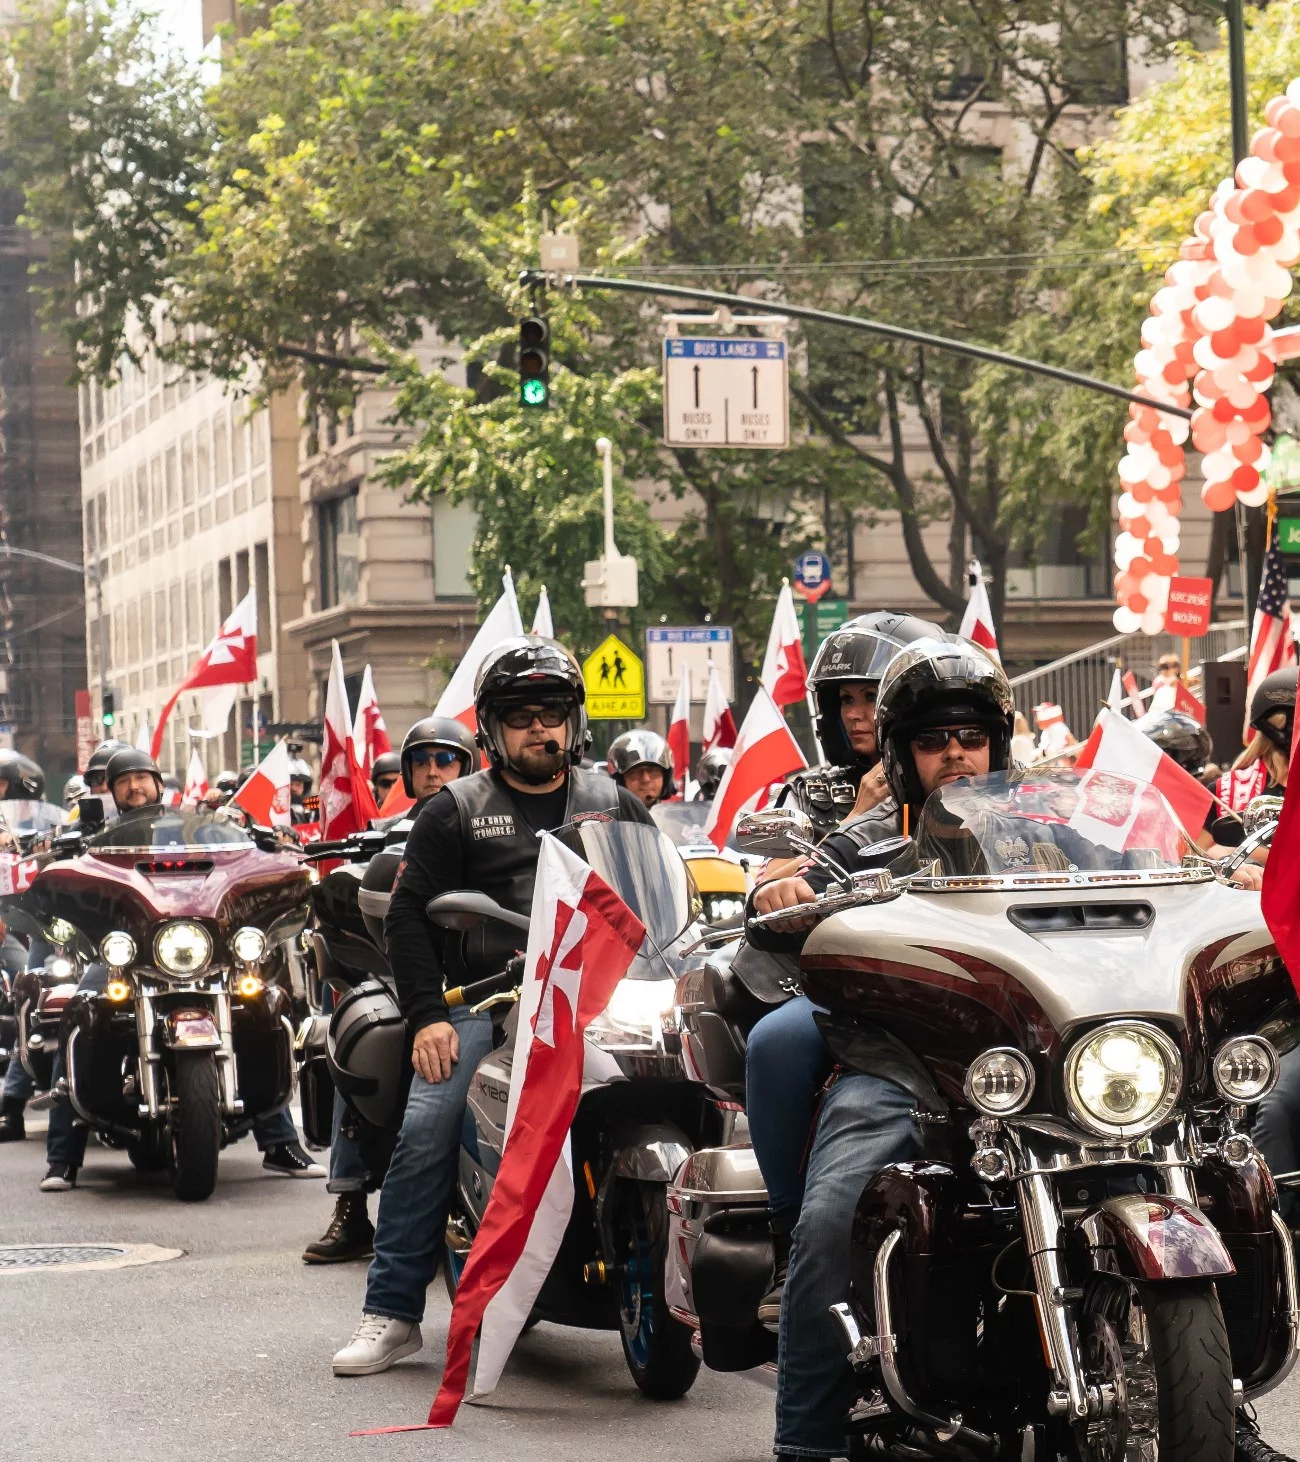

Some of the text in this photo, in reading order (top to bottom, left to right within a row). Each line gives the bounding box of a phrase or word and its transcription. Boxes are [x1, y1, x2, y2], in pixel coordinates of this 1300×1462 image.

[694, 342, 757, 356] BUS LANES
[682, 413, 712, 425] BUSES
[741, 414, 771, 425] BUSES
[684, 428, 710, 439] ONLY
[743, 430, 769, 440] ONLY
[821, 663, 852, 672] SHARK
[591, 701, 639, 712] AHEAD
